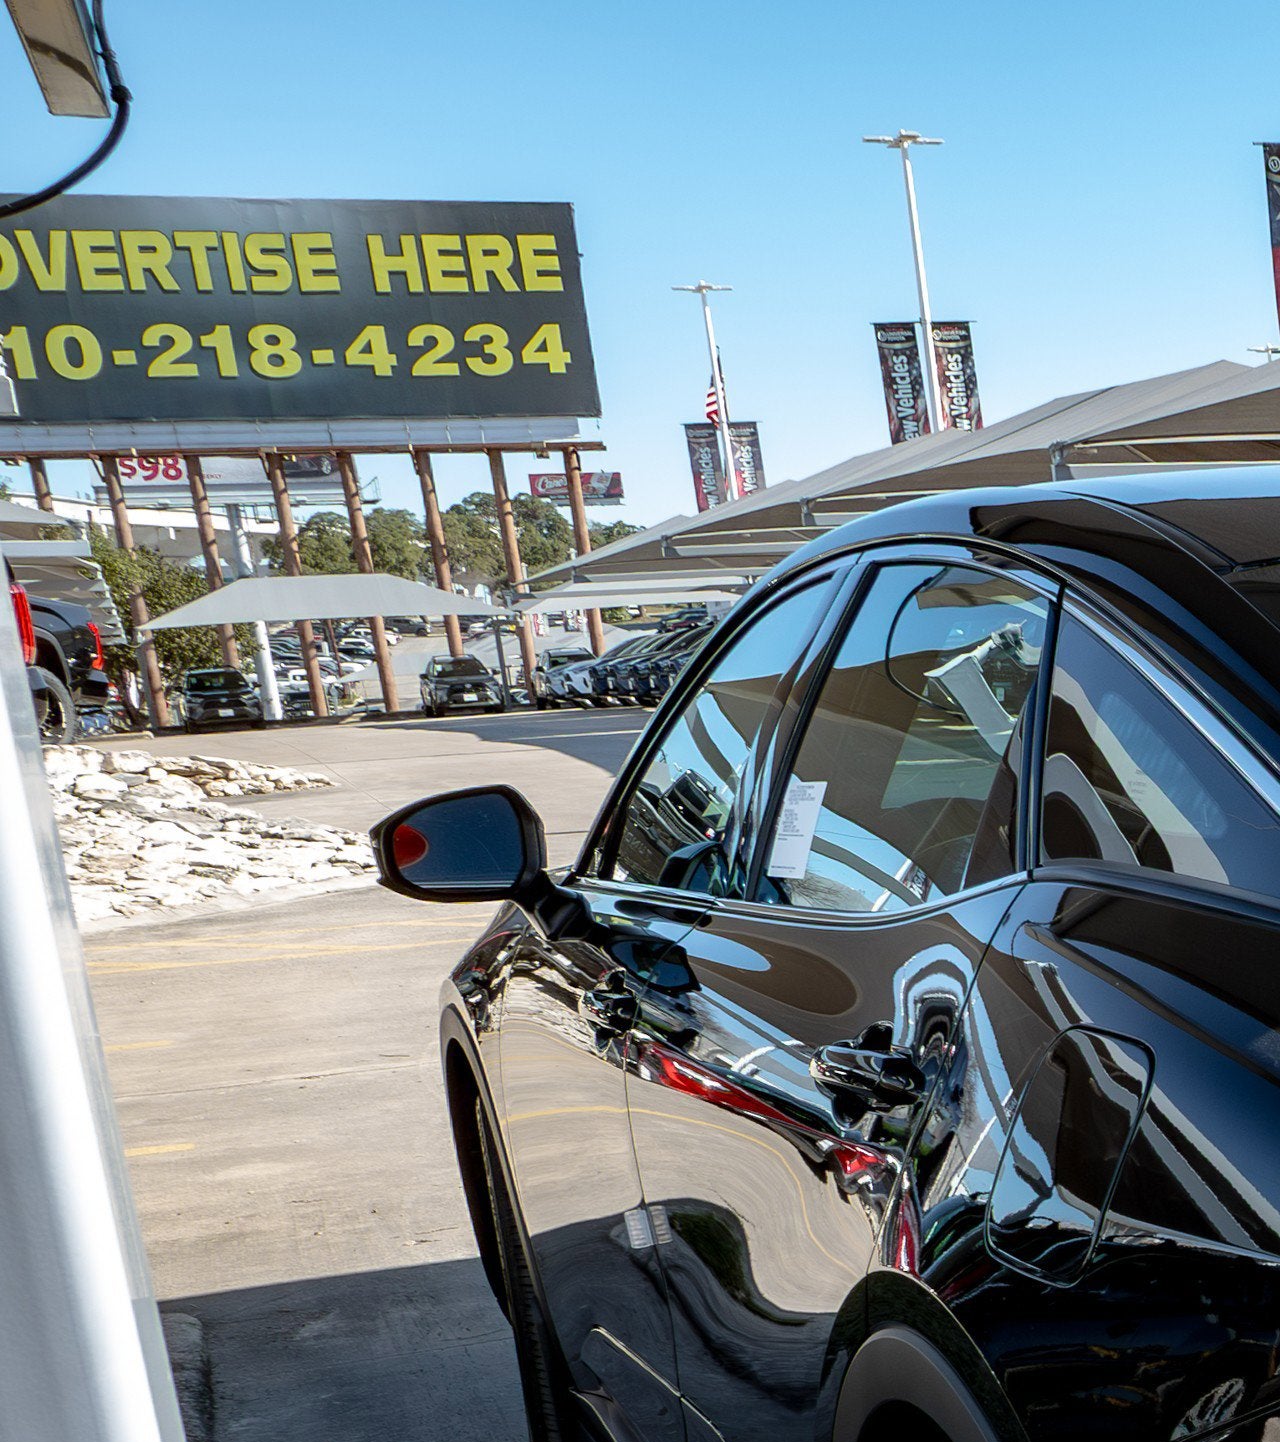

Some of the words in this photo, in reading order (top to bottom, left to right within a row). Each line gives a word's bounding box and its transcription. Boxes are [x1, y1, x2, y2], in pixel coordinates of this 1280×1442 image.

[367, 233, 565, 293] HERE
[891, 354, 916, 419] Vehicles
[944, 353, 969, 418] Vehicles
[698, 446, 718, 494] Vehicles
[739, 445, 759, 492] Vehicles
